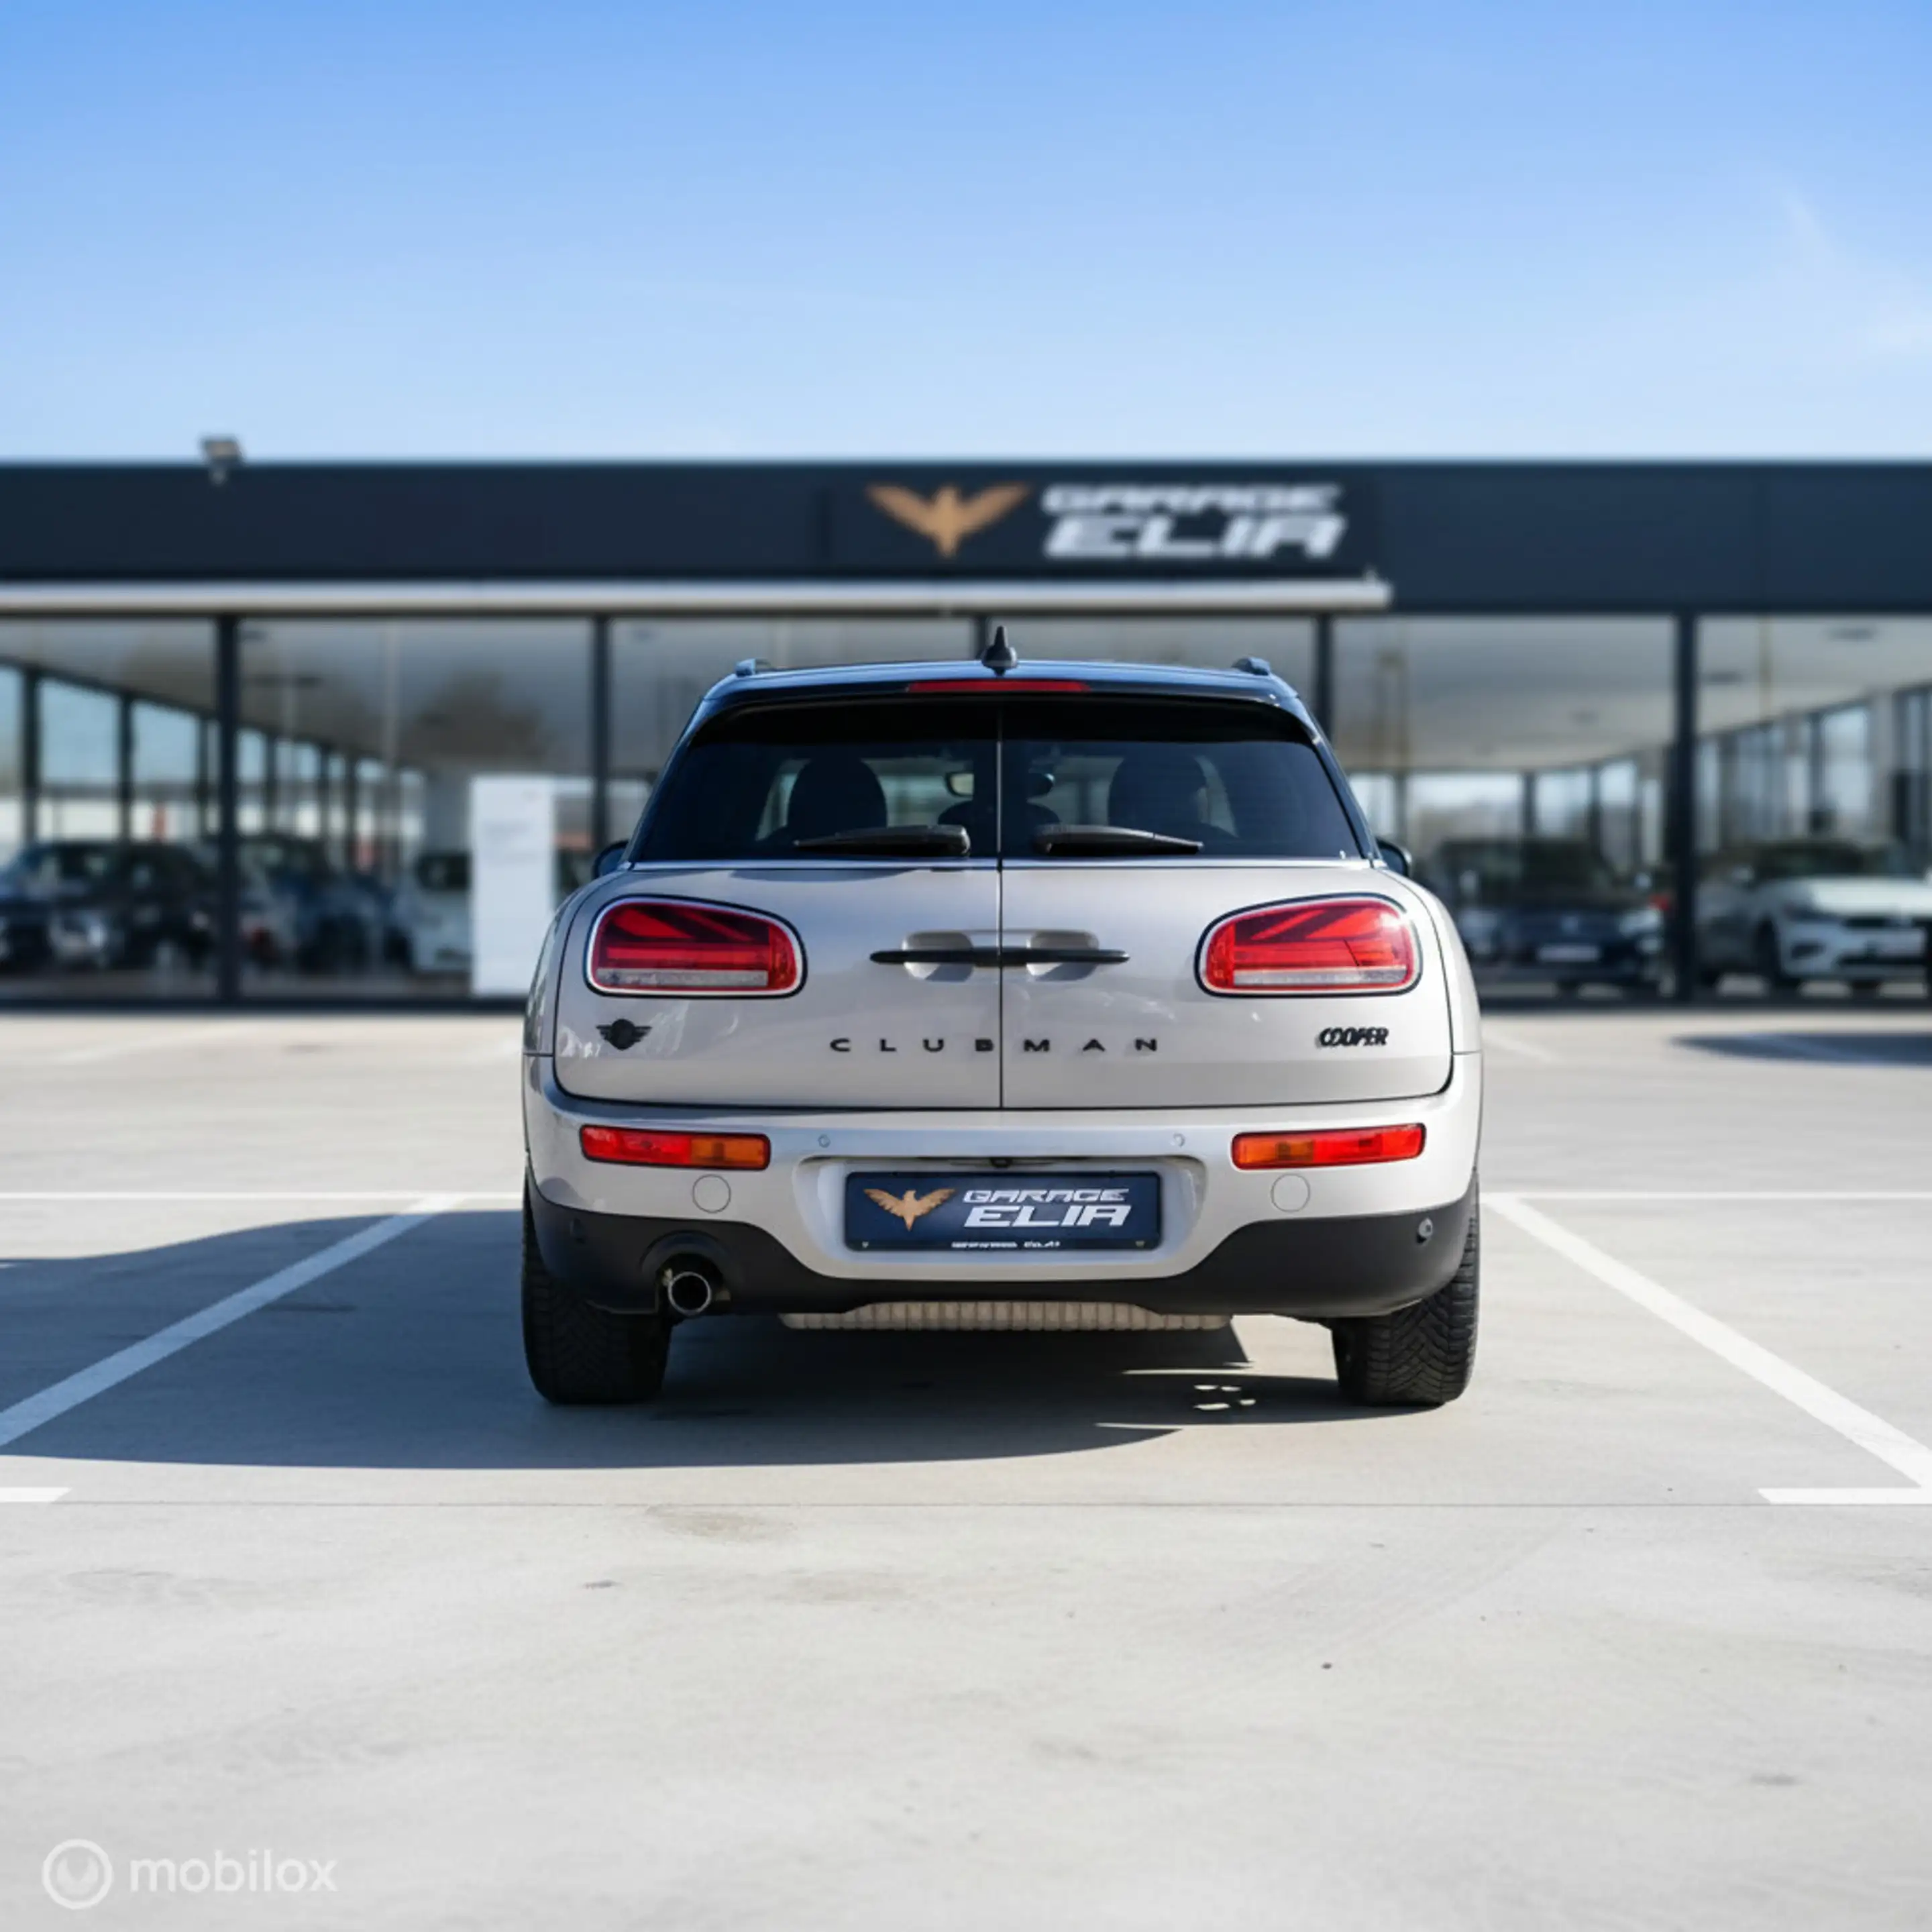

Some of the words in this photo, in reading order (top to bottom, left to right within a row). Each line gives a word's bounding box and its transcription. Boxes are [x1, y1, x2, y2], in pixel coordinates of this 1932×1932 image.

[1041, 483, 1340, 514] GARAGE
[1043, 515, 1345, 559] ELIA
[829, 1038, 1158, 1053] CLUBMAN
[1318, 1026, 1389, 1047] COOPER
[963, 1188, 1130, 1203] GARAGE
[963, 1205, 1132, 1228] ELIA
